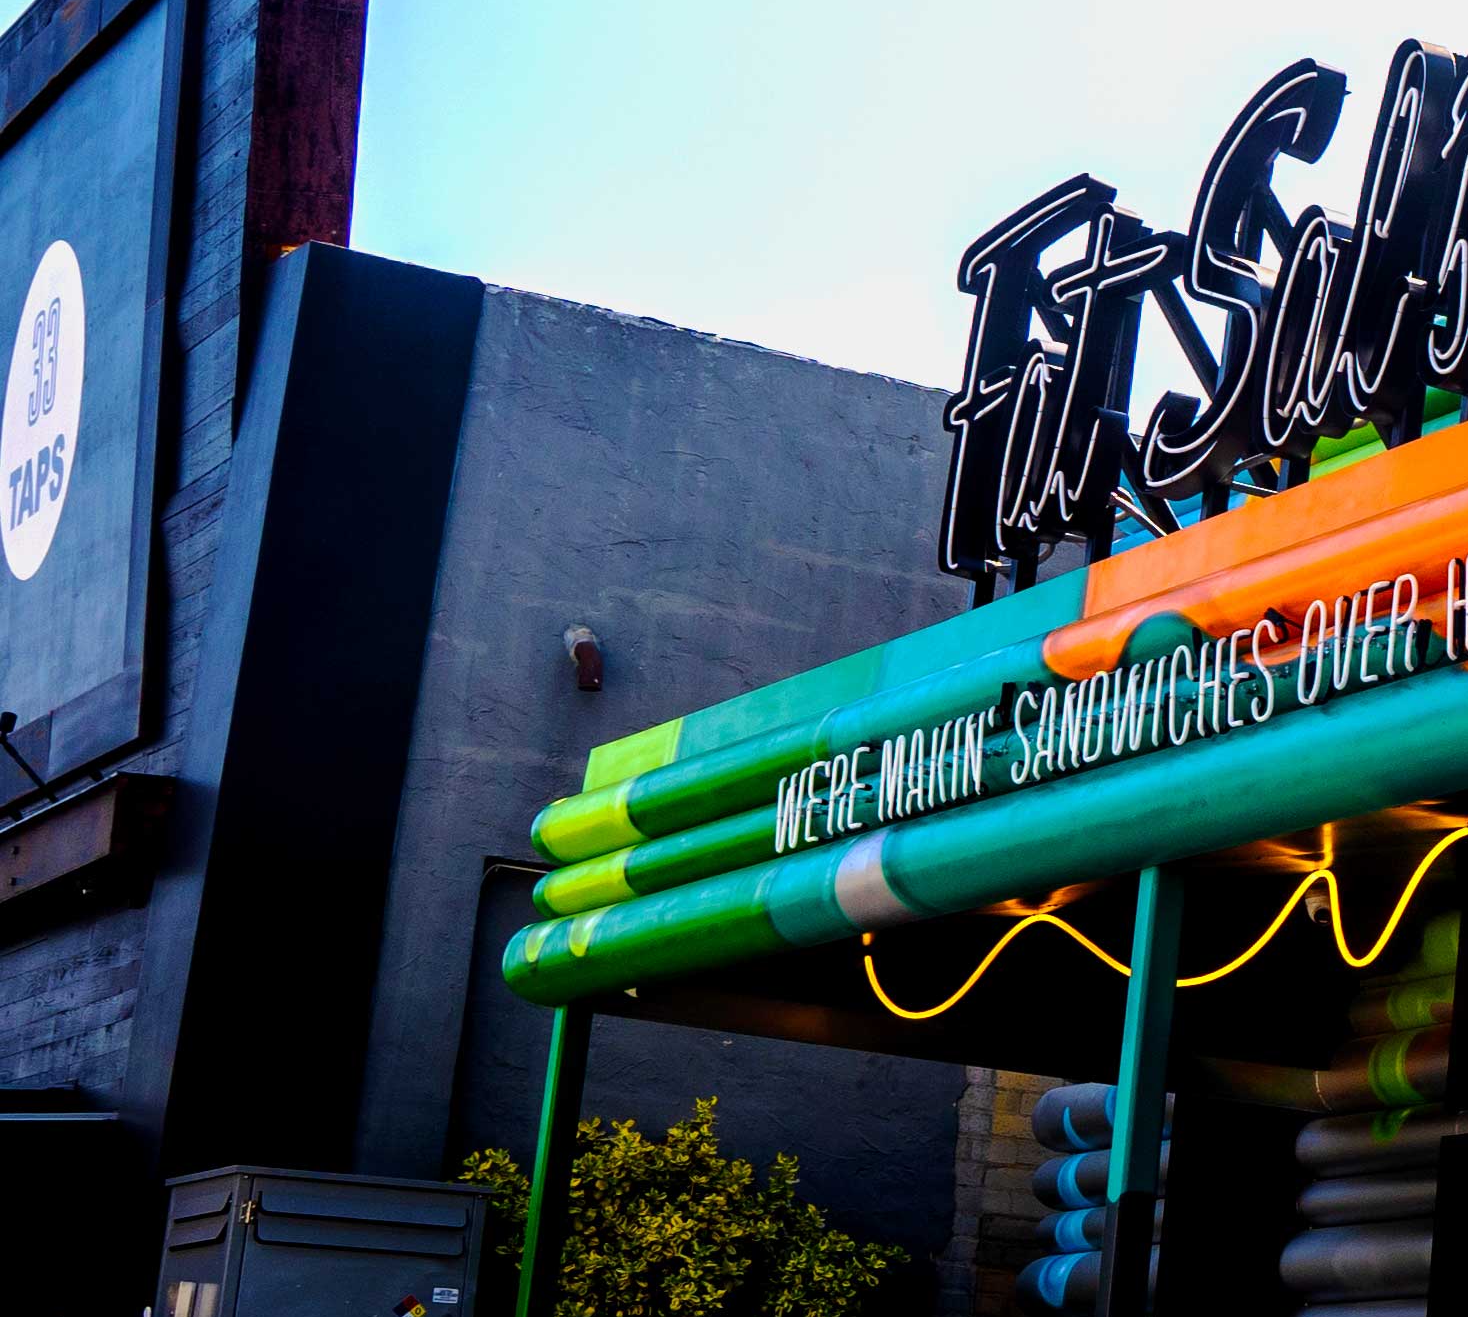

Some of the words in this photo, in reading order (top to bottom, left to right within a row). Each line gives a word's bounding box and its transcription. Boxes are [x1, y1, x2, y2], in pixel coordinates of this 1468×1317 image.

[29, 296, 60, 426] 33
[938, 173, 1186, 579] Fat
[9, 434, 65, 531] TAPS
[878, 705, 996, 822] MAKIN'
[1011, 619, 1279, 784] SANDWICHES
[1297, 573, 1418, 705] OVER
